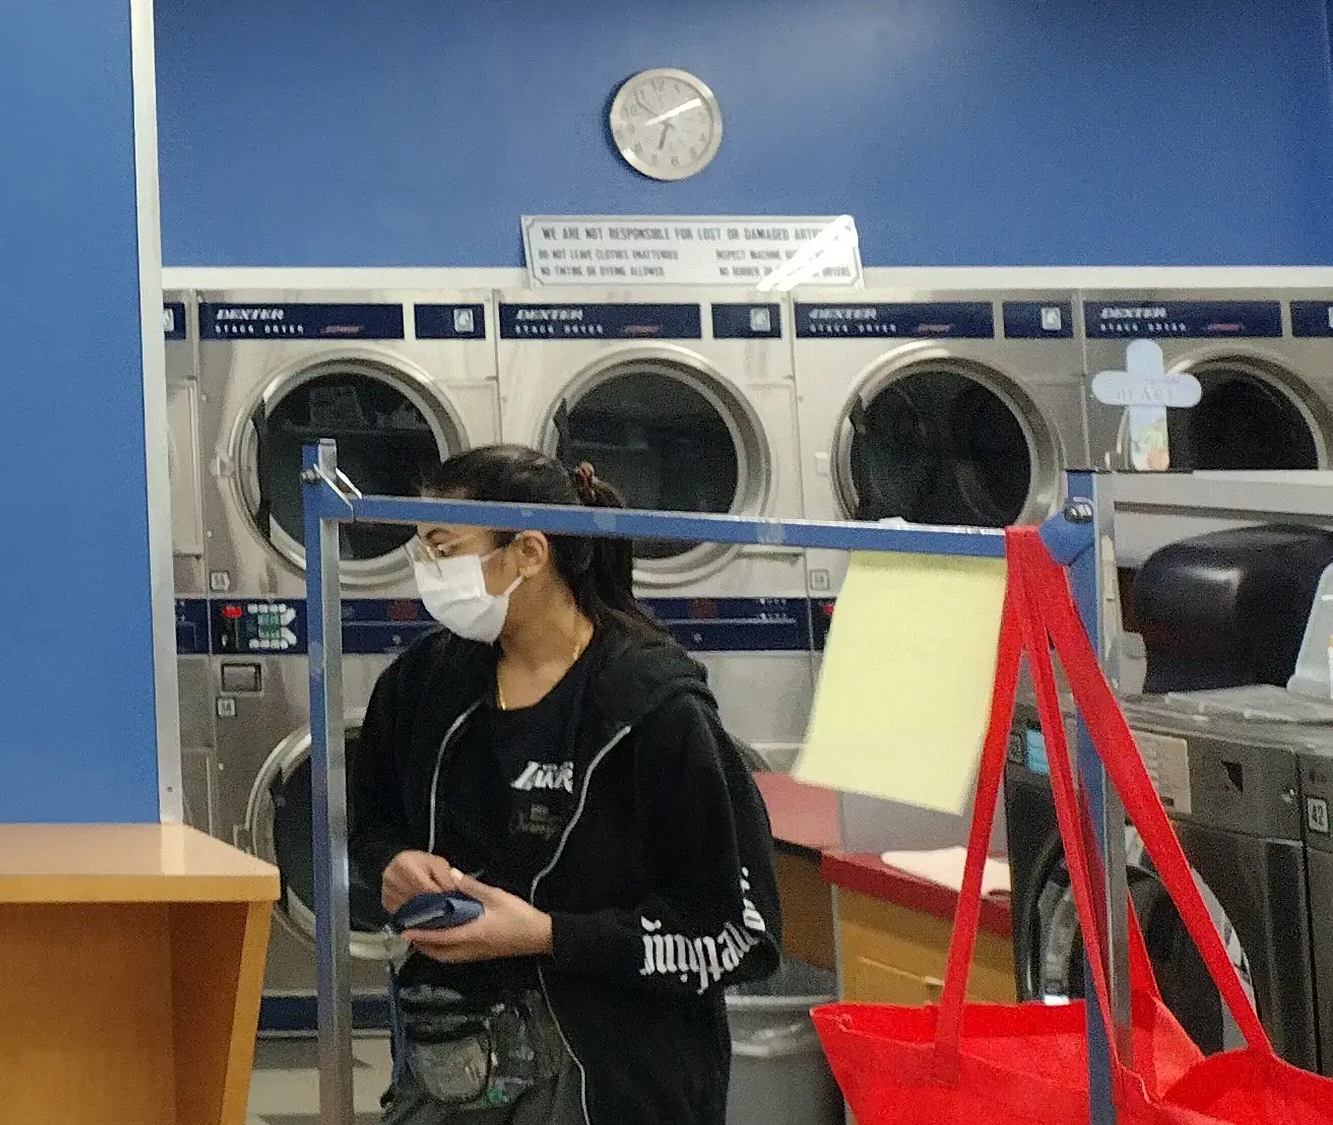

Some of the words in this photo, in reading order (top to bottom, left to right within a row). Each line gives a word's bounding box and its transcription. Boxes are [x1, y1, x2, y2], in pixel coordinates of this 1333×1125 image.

[542, 227, 556, 240] WE
[563, 227, 581, 240] ARE
[585, 227, 603, 240] NOT
[608, 227, 670, 240] RESPONSIBLE
[674, 227, 693, 240] FOR
[697, 227, 721, 241] LOST
[727, 227, 740, 240] OR
[744, 227, 789, 241] DAMAGED
[217, 309, 284, 320] DEXTER
[516, 309, 583, 320] DEXTER
[809, 308, 877, 319] DEXTER
[1101, 307, 1167, 318] DEXTER
